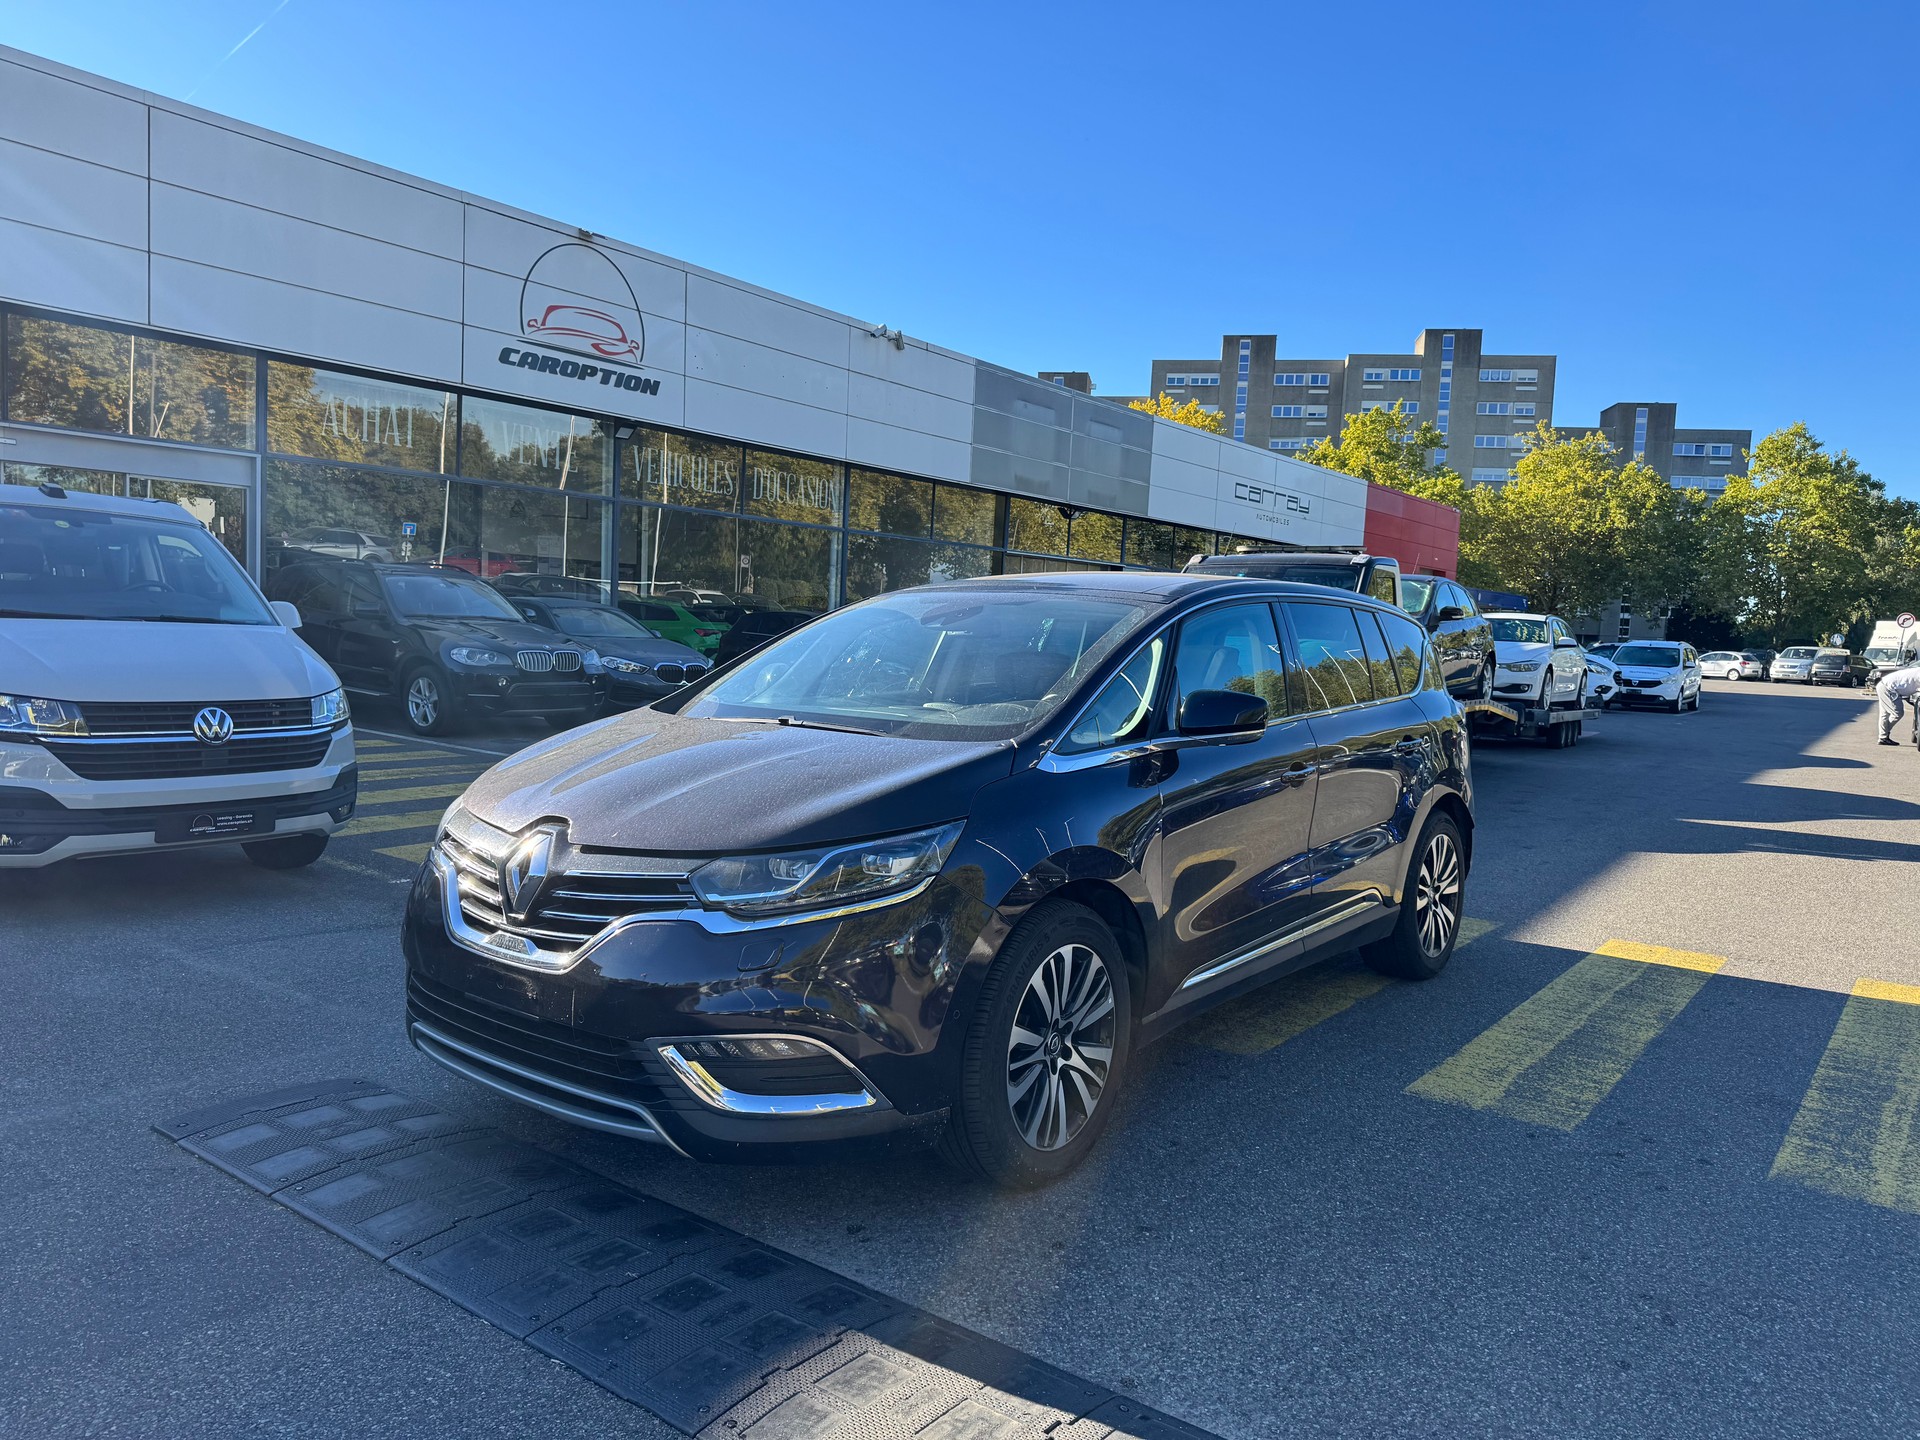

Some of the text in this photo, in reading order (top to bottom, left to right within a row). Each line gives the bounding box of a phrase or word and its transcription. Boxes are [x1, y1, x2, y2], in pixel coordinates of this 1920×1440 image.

[498, 347, 661, 396] CAROPTION
[321, 393, 413, 448] ACHAT
[502, 421, 578, 473] VENTE
[753, 466, 839, 512] D'OCCASION
[1234, 482, 1311, 514] carray
[1255, 513, 1290, 526] AUTOMOBILES
[1006, 940, 1043, 1003] BRAVURIS
